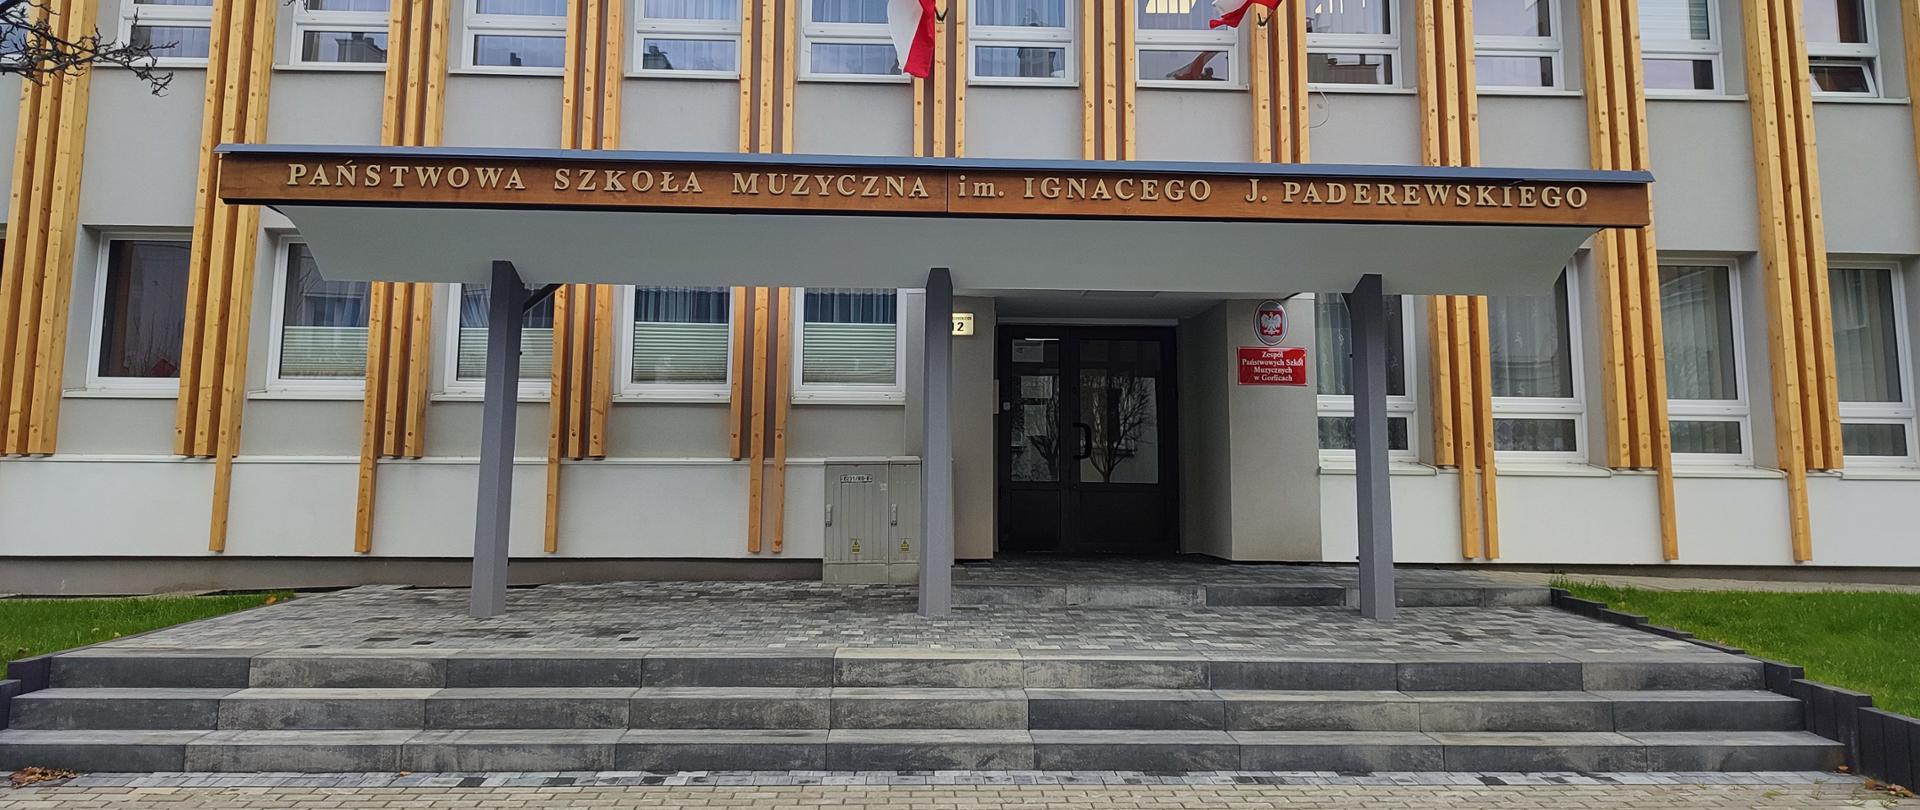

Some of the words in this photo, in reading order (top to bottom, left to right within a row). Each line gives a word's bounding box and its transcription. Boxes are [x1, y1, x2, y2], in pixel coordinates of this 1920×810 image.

[286, 160, 526, 191] PAŃSTWOWA
[553, 167, 703, 193] SZKOŁA
[731, 171, 929, 198] MUZYCZNA
[957, 175, 1006, 198] im.
[1023, 177, 1212, 201] IGNACEGO
[1245, 178, 1268, 202] J.
[1282, 181, 1588, 208] PADEREWSKIEGO
[1253, 366, 1293, 374] Muzycznych
[1261, 374, 1293, 382] Gorlicach
